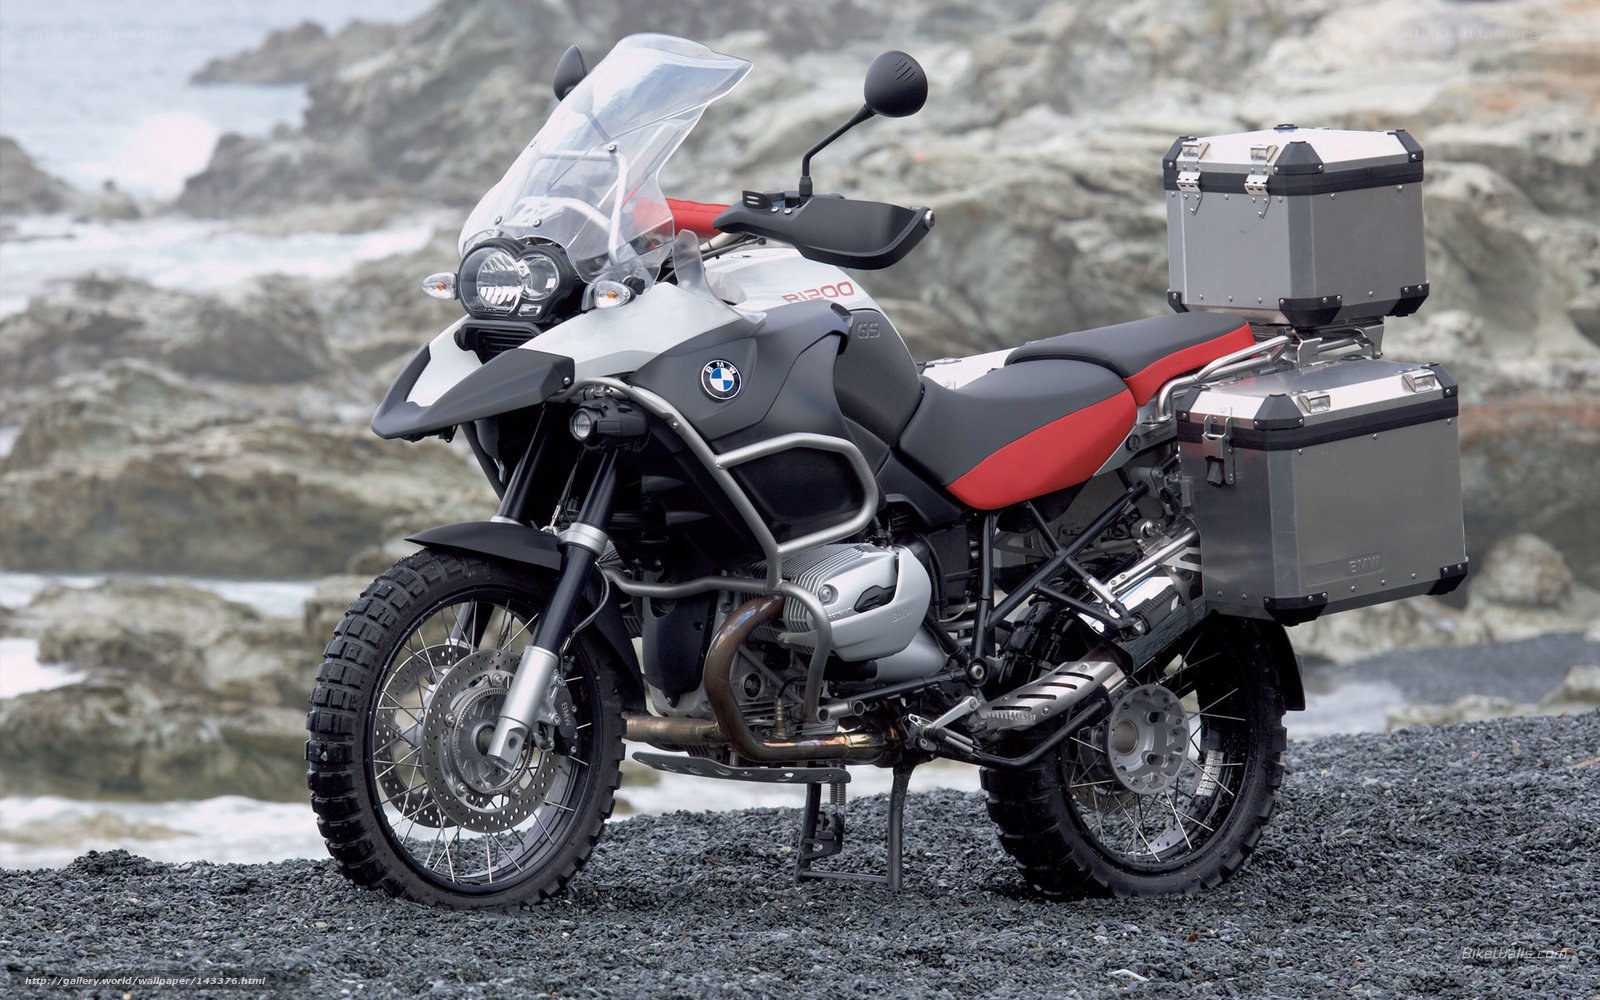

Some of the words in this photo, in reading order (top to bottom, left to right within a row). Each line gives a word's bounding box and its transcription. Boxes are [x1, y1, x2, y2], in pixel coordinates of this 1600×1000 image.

[857, 321, 880, 339] GS
[1349, 554, 1381, 573] BMW
[561, 702, 571, 726] BMW
